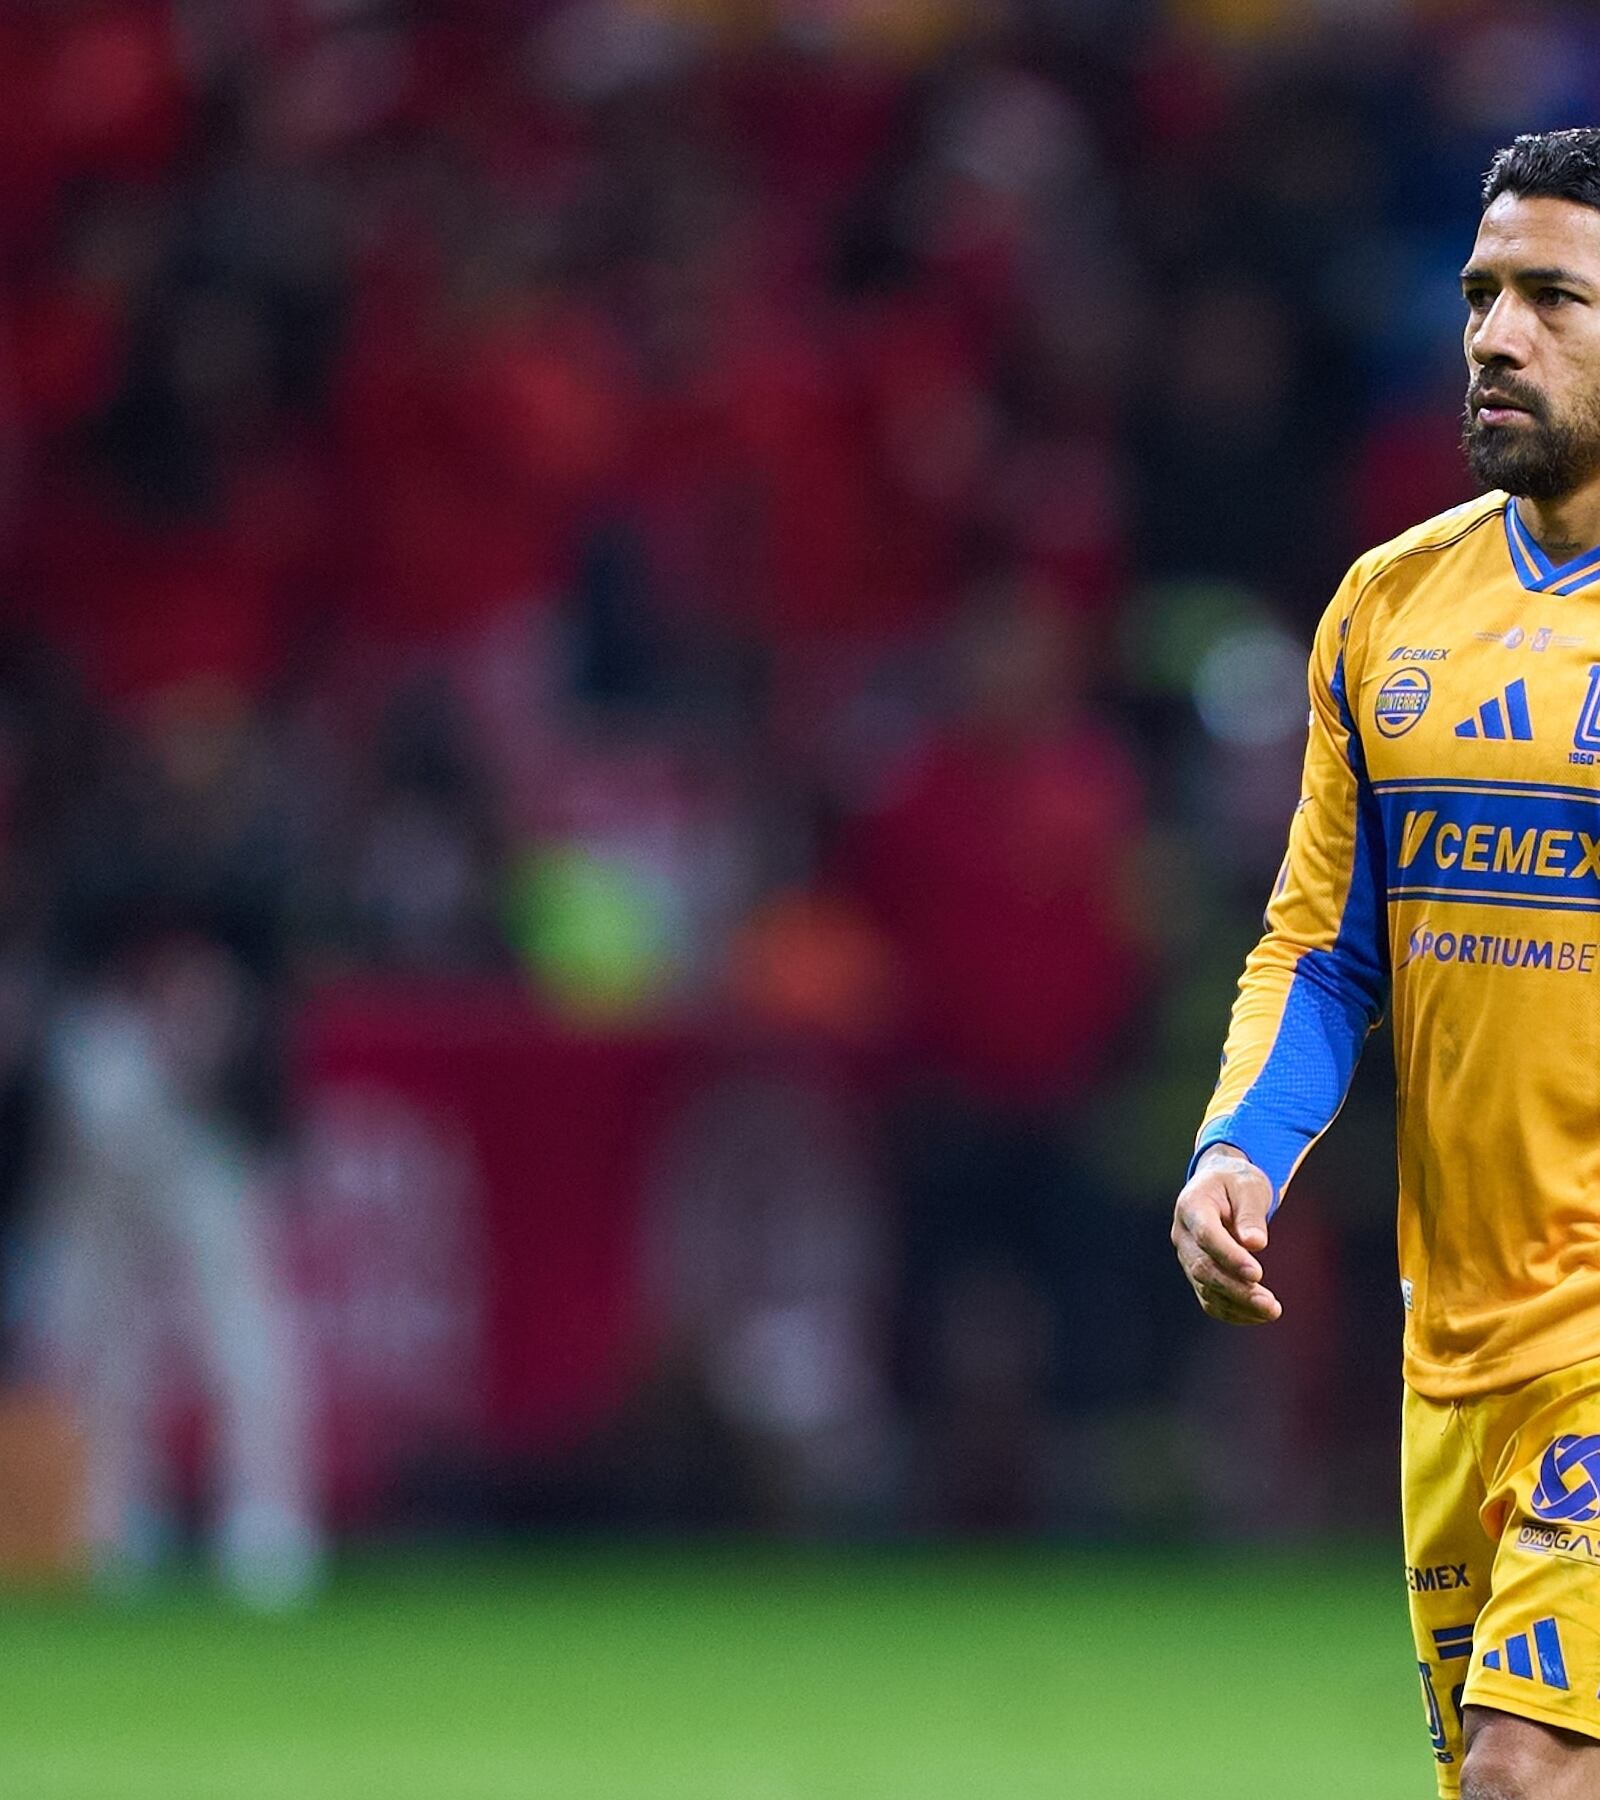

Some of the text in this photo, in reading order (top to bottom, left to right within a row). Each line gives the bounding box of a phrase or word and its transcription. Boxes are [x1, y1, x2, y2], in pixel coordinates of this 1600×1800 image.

[1402, 648, 1451, 661] CEMEX
[1376, 691, 1430, 711] MONTERREY
[1568, 752, 1594, 765] 1960
